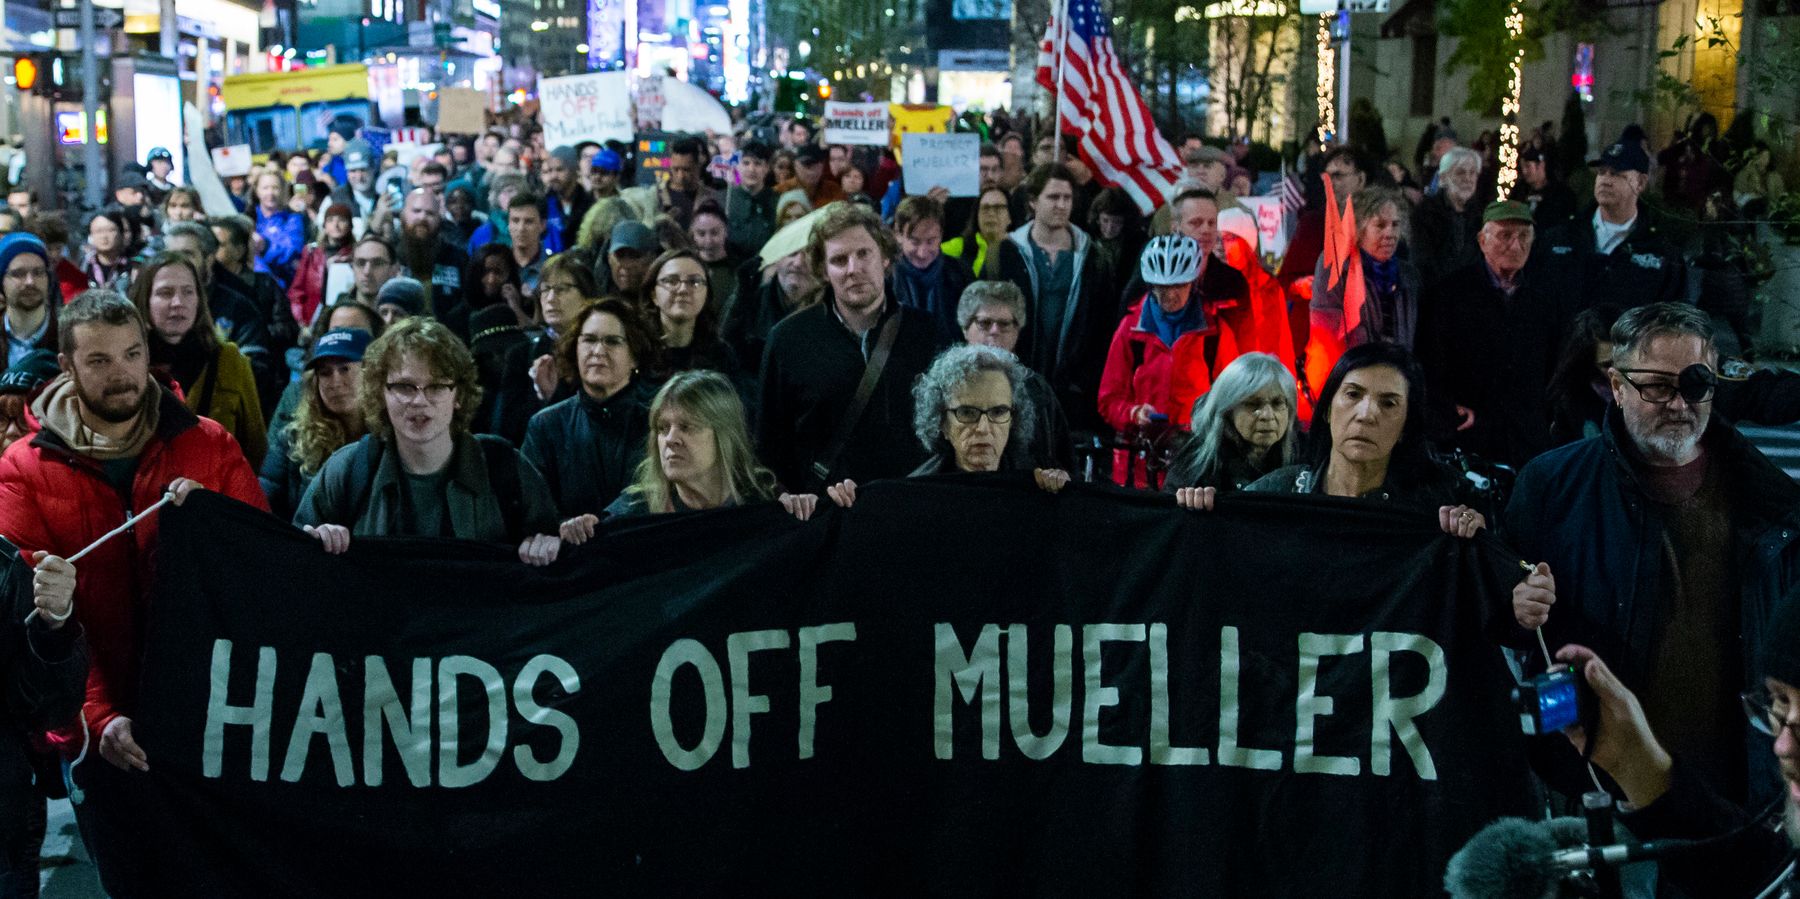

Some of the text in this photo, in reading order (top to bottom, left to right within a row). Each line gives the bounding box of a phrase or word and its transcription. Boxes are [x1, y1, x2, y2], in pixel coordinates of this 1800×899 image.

[546, 80, 597, 100] HANDS
[562, 95, 597, 117] OFF
[825, 119, 885, 130] MUELLER
[203, 622, 1448, 788] HANDS OFF MUELLER
